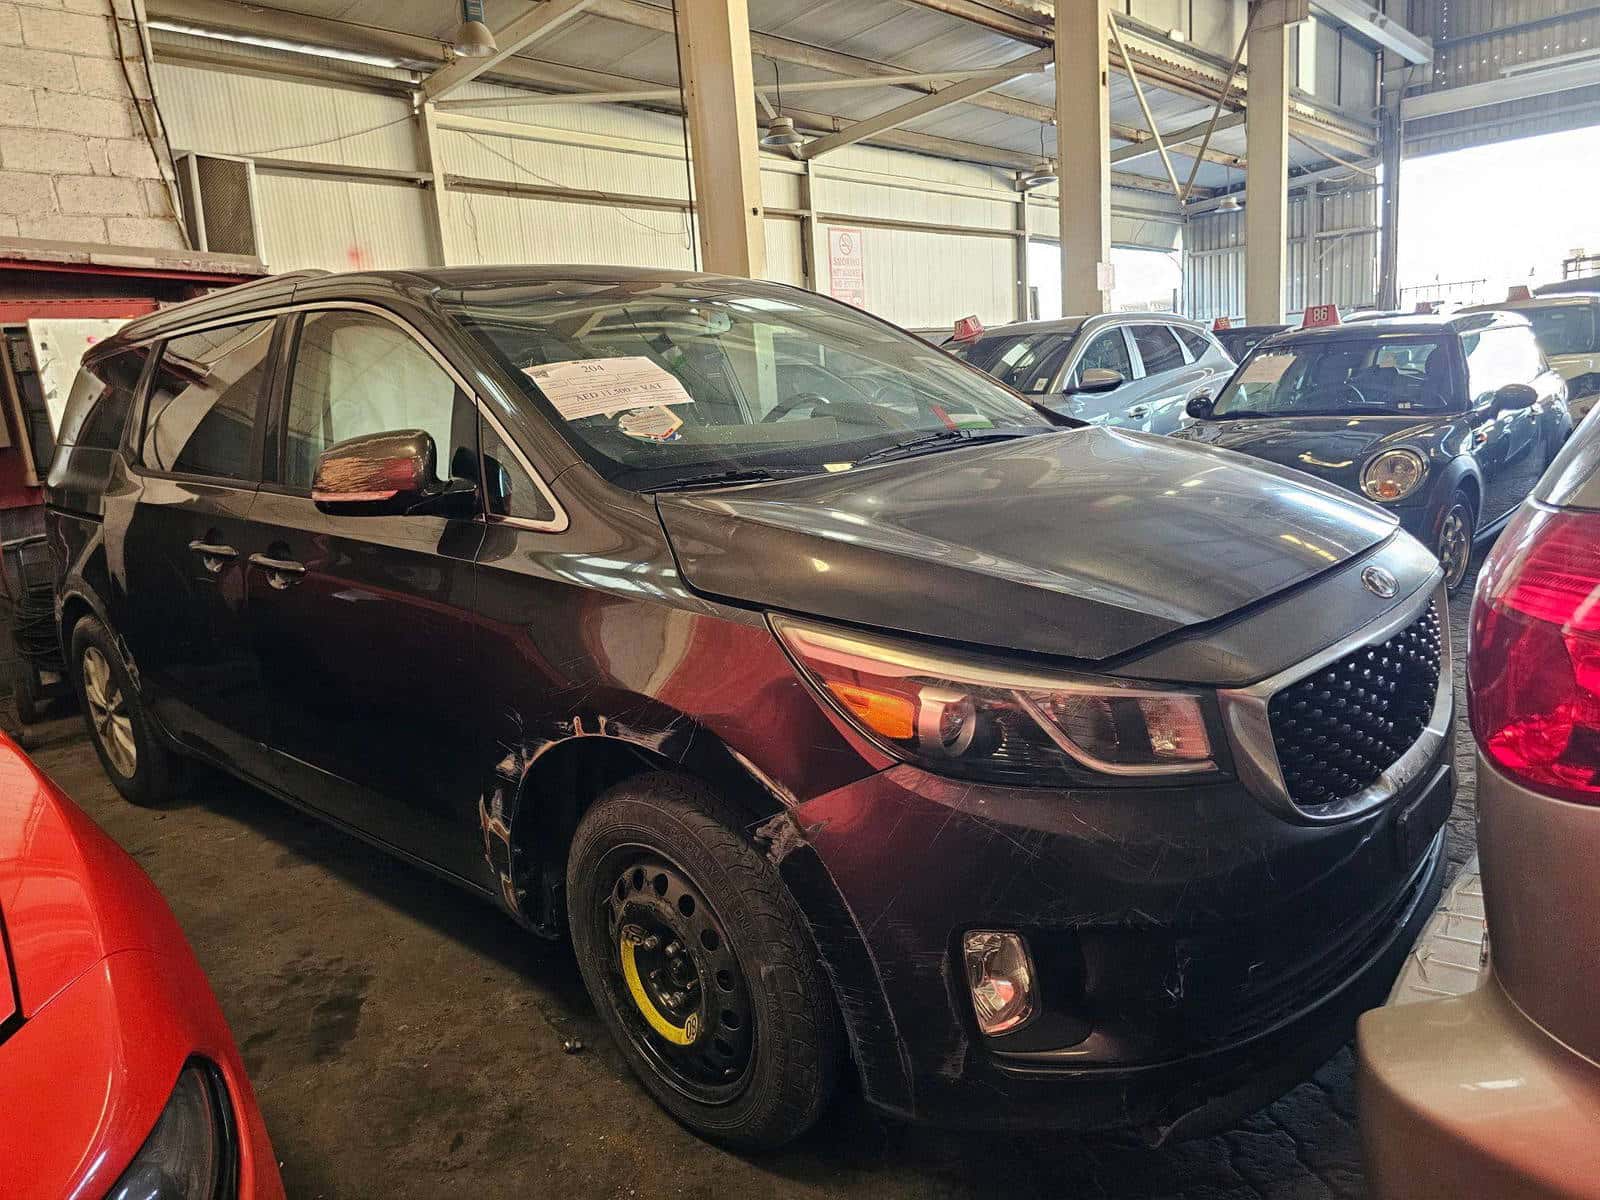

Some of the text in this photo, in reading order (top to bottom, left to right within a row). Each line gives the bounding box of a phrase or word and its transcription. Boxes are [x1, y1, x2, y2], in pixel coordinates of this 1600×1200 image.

[1313, 307, 1328, 321] 86
[581, 364, 604, 373] 204
[576, 391, 598, 401] AED
